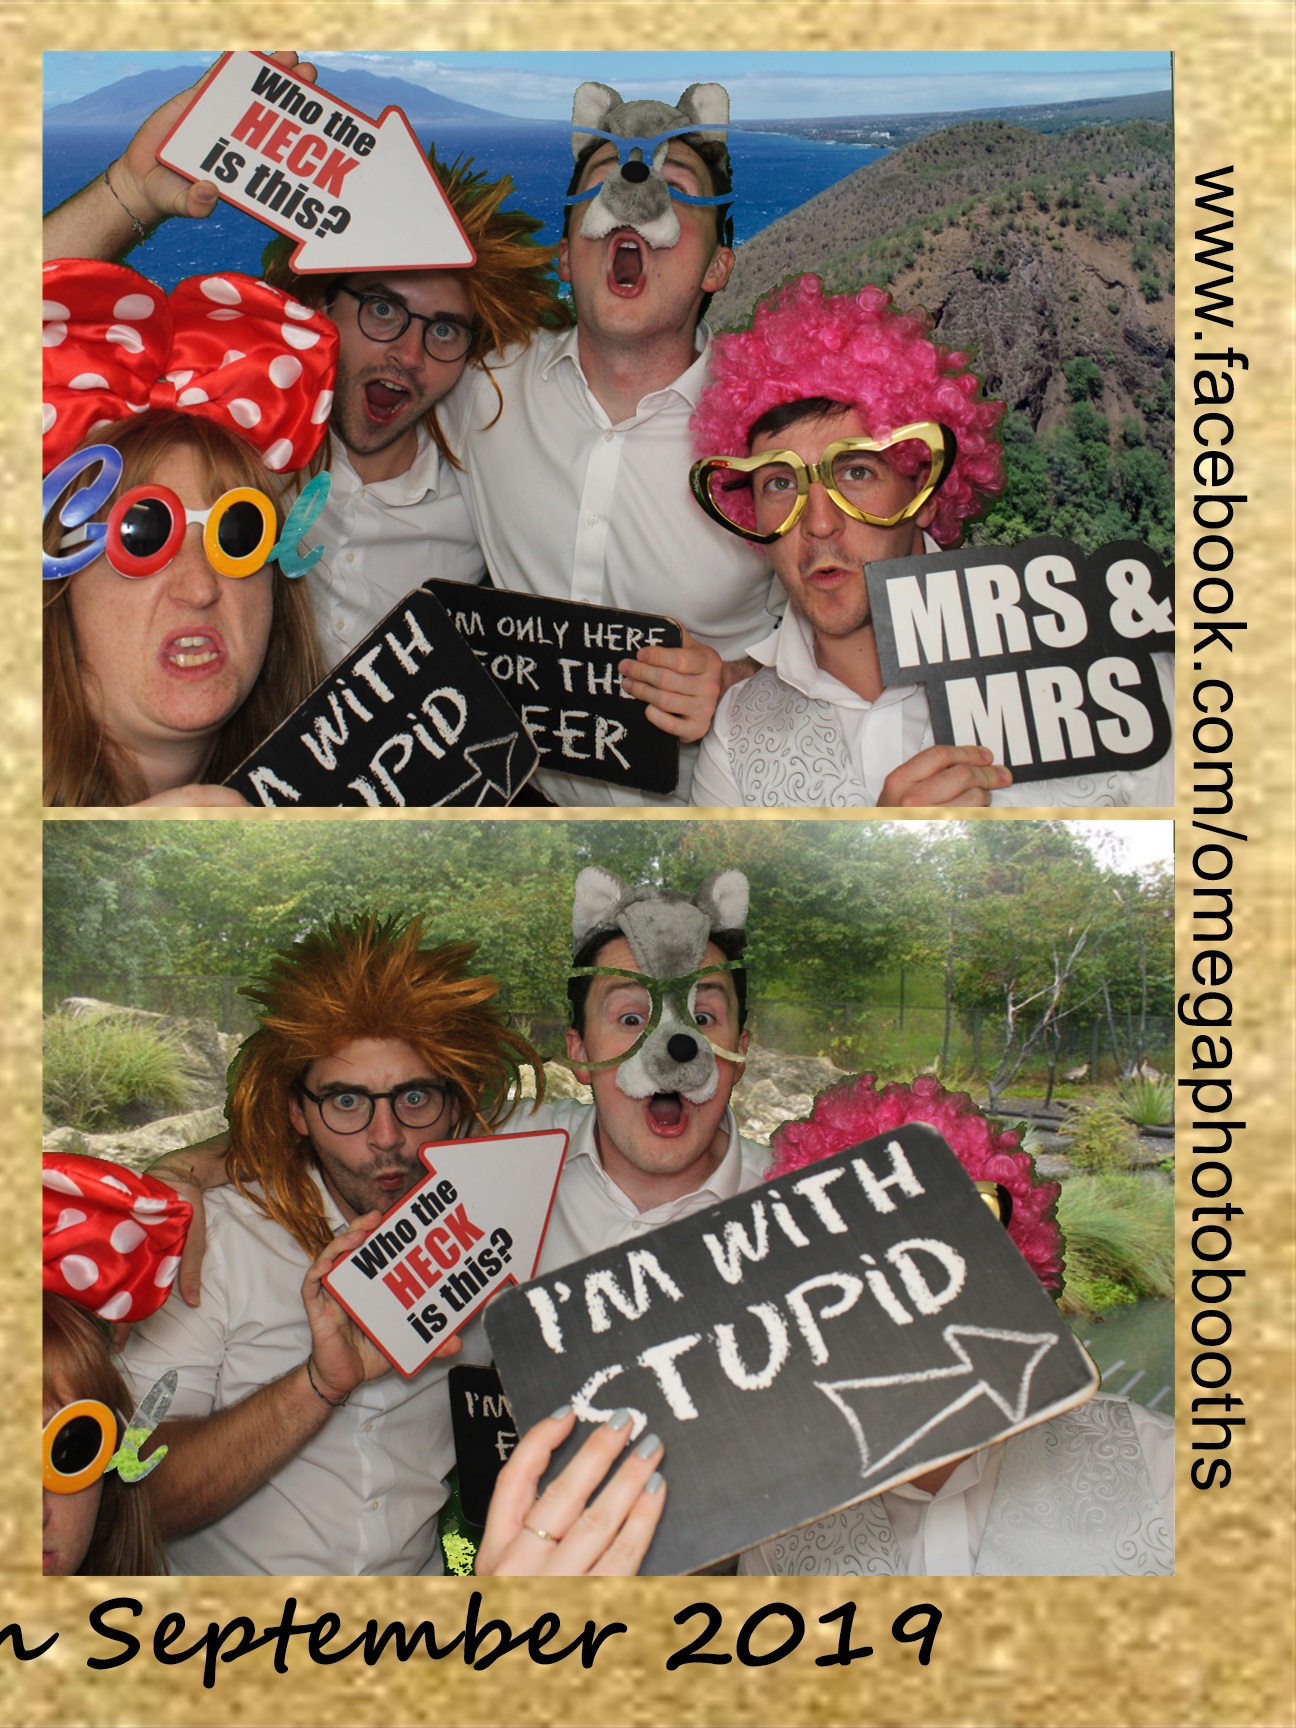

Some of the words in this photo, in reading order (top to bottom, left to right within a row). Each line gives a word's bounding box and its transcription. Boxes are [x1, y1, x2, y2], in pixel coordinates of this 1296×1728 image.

[230, 100, 360, 199] HECK
[250, 66, 322, 125] Who
[322, 108, 376, 157] the
[199, 137, 241, 185] is
[243, 165, 352, 240] this?
[497, 616, 570, 650] ONLY
[885, 554, 1089, 669] MRS
[1105, 558, 1176, 640] &
[473, 649, 540, 691] OR
[944, 656, 1154, 768] MRS
[521, 704, 631, 770] EER
[351, 1217, 418, 1281] Who
[410, 1178, 459, 1234] the
[381, 1202, 486, 1311] HECK
[406, 1303, 448, 1344] is
[439, 1226, 515, 1317] this?
[526, 1249, 684, 1354] I'M
